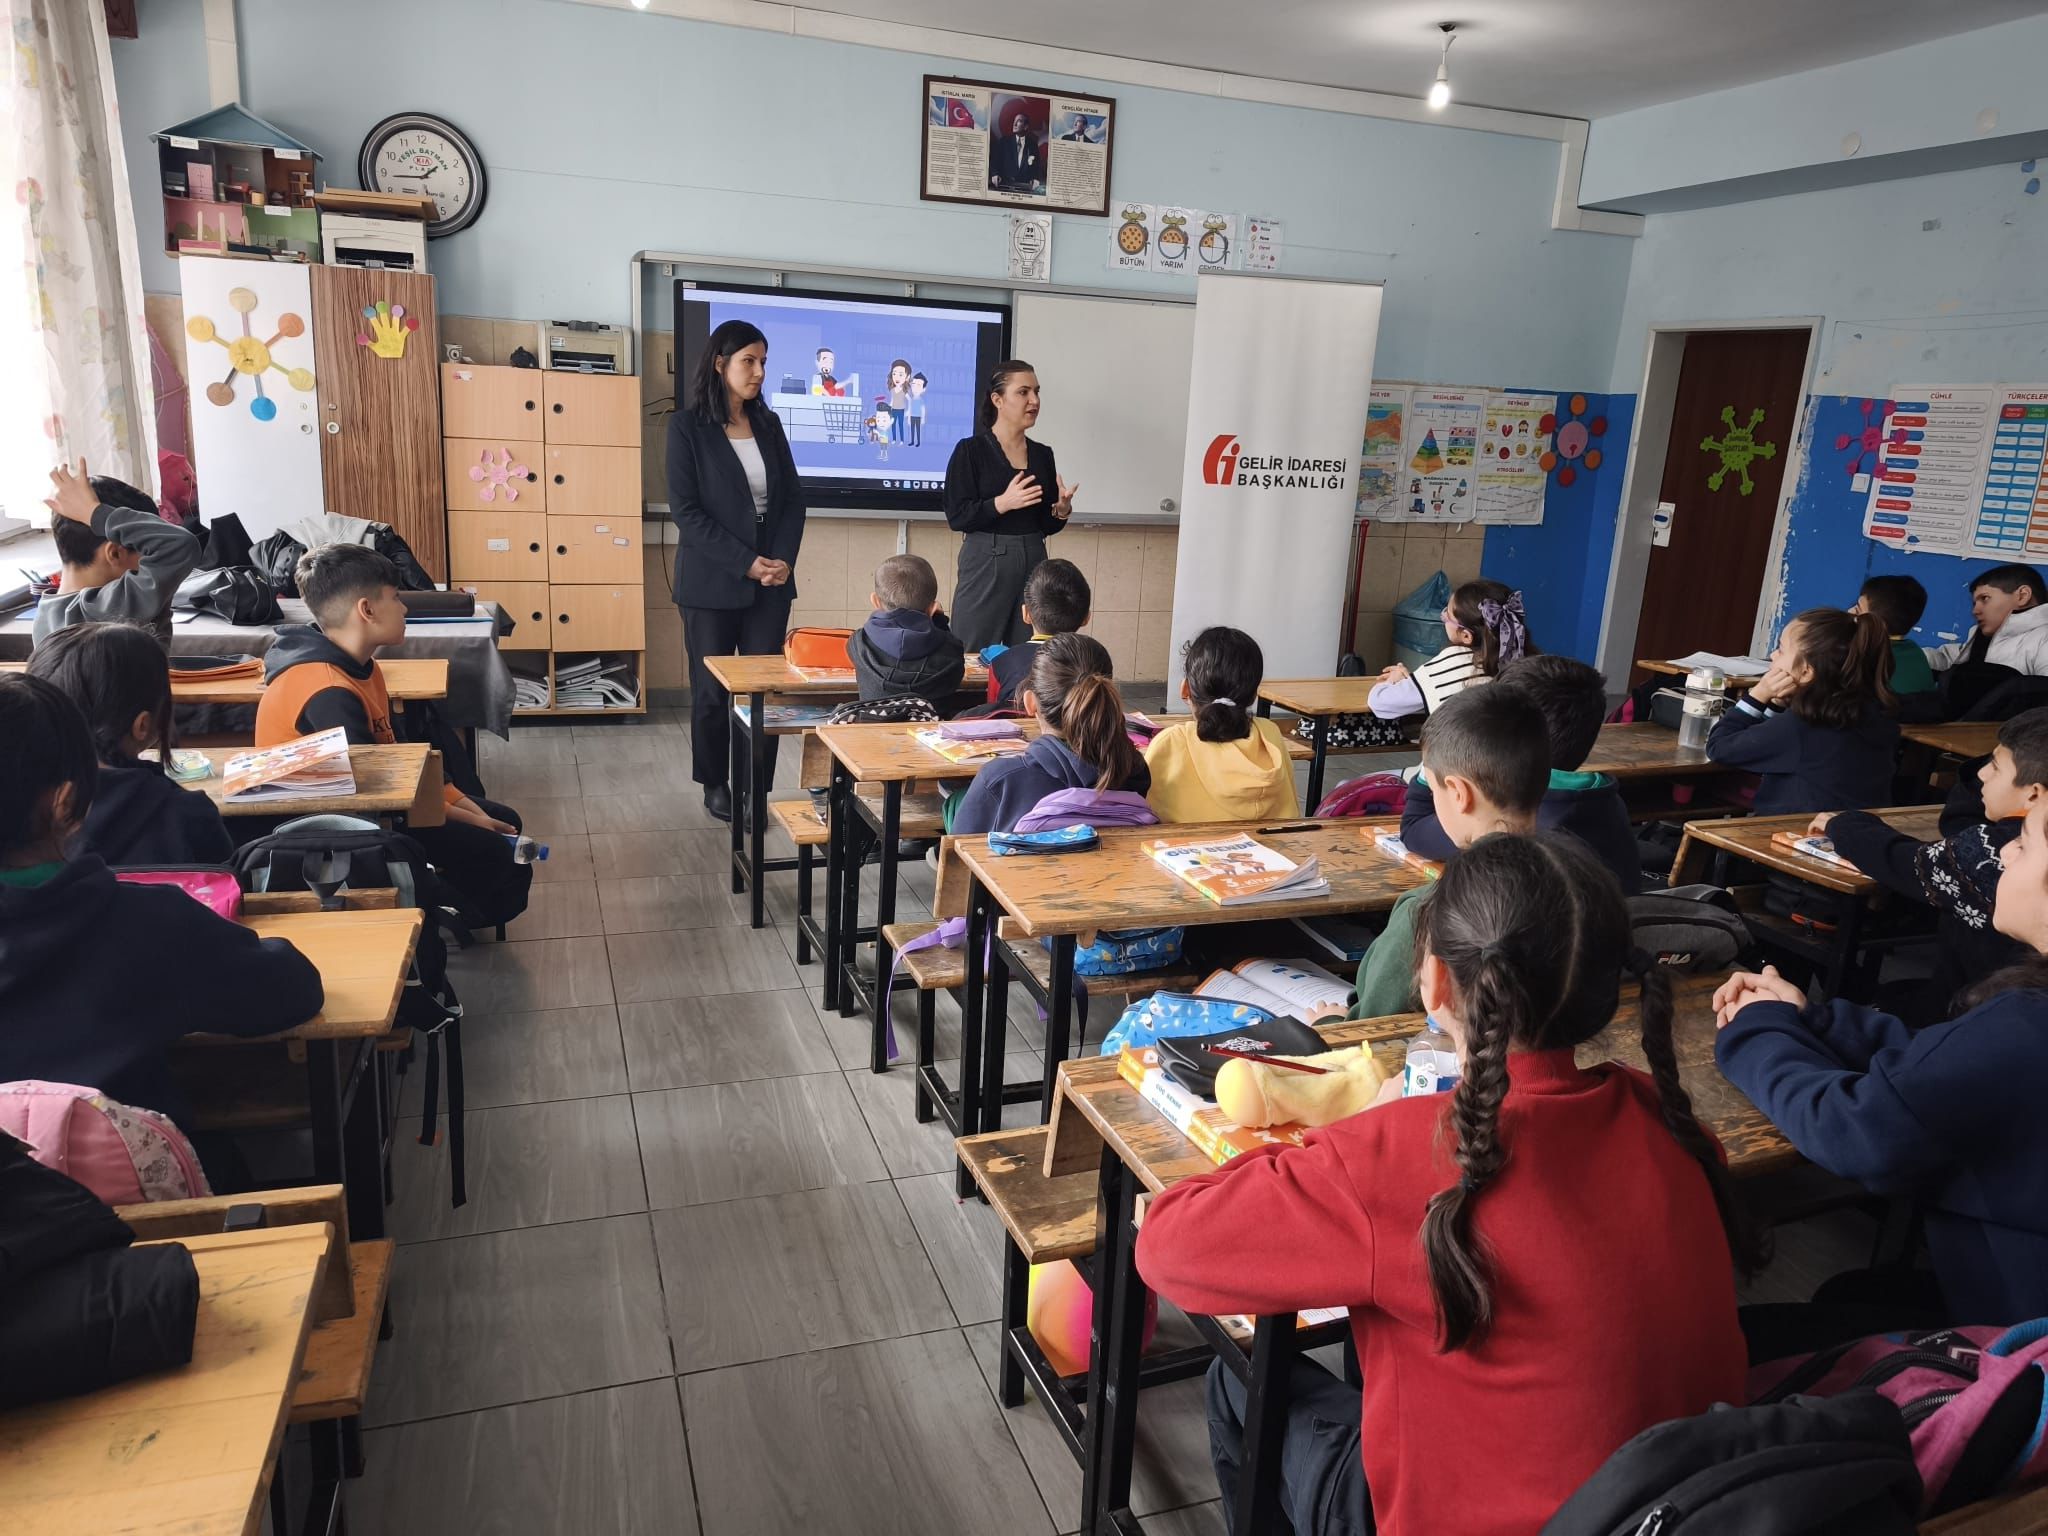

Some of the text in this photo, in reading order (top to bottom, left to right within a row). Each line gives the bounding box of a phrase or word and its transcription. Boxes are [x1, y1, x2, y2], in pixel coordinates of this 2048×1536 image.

[400, 138, 408, 147] 11
[416, 134, 427, 145] 12
[439, 143, 444, 151] 1
[386, 151, 396, 161] 10
[416, 157, 430, 165] KIA
[418, 147, 448, 171] BATMAN
[453, 158, 459, 168] 2
[380, 167, 388, 177] 9
[458, 176, 465, 186] 3
[453, 194, 459, 203] 4
[440, 206, 447, 216] 5
[1119, 256, 1144, 267] BÜTÜN
[1160, 259, 1184, 269] YARIM
[1930, 392, 1952, 400] CÜMLE
[1239, 455, 1347, 473] GELİR İDARESİ
[1237, 473, 1345, 490] BAŞKANLIĞI
